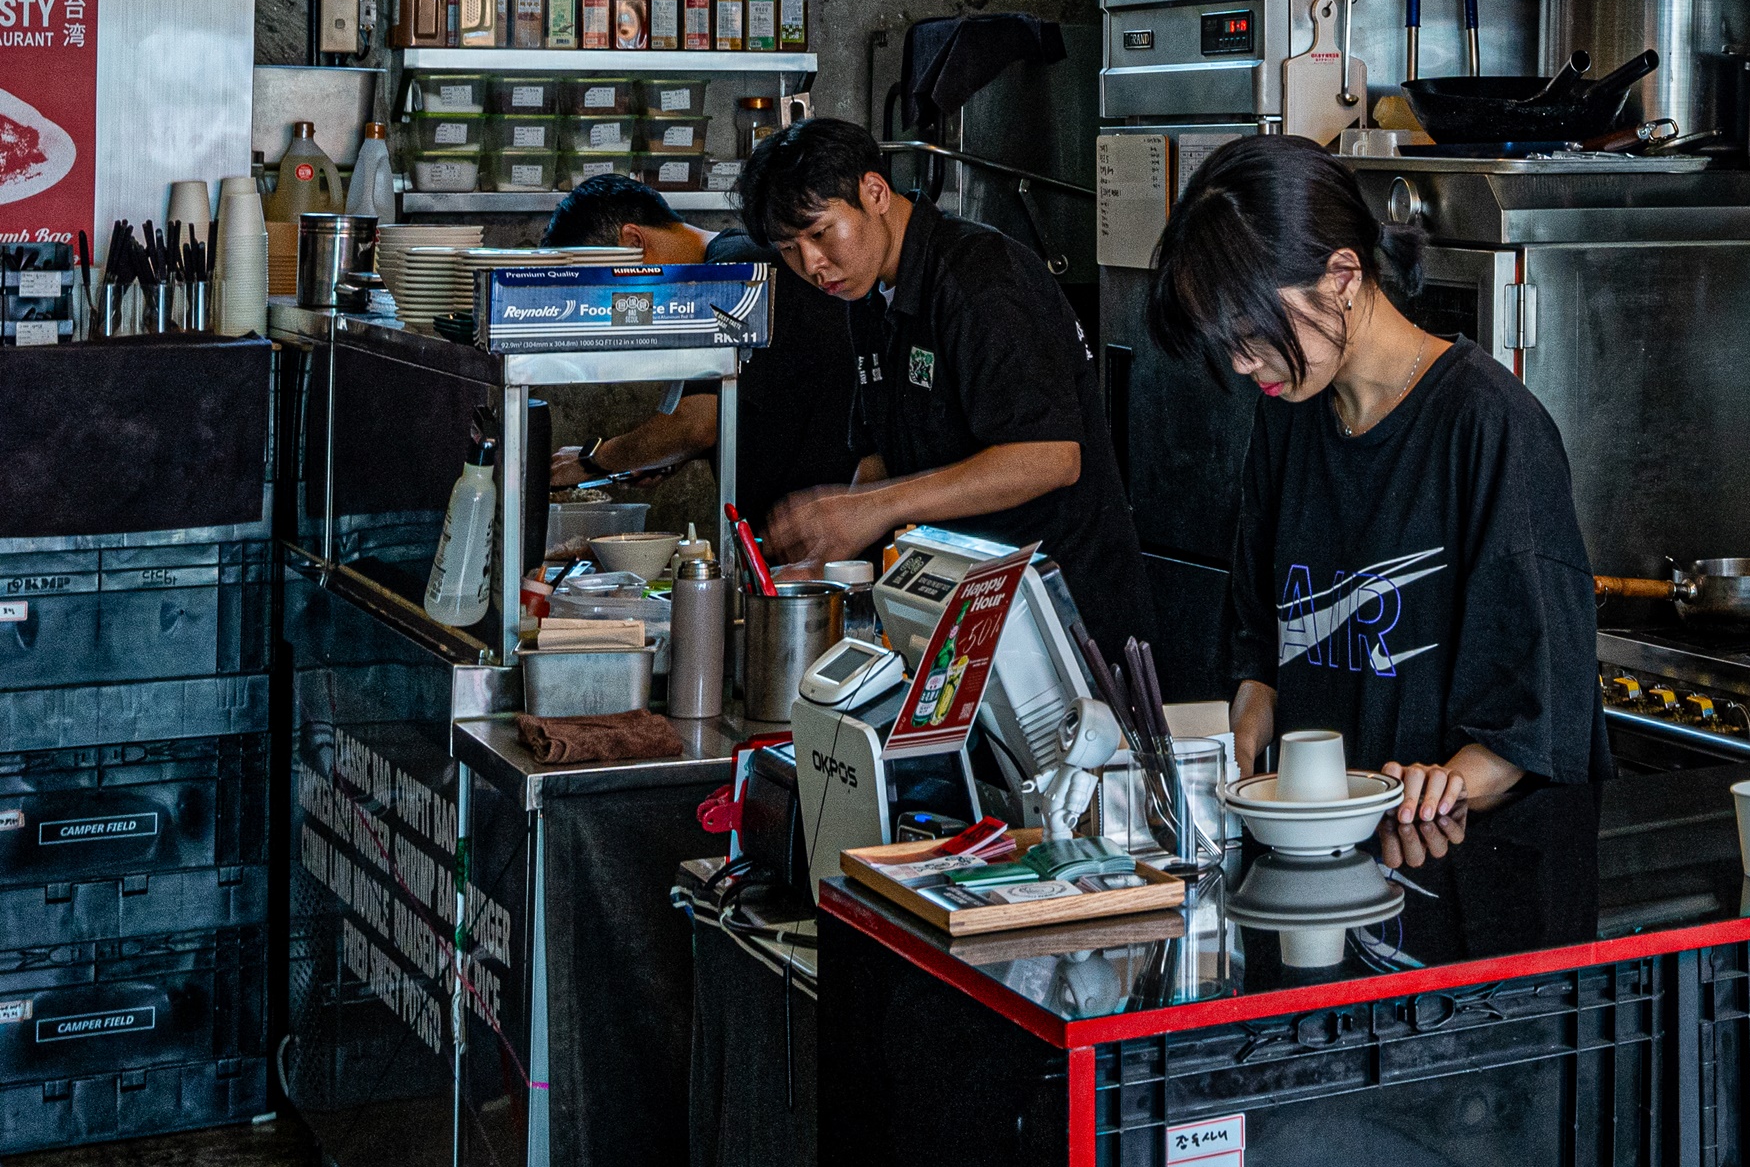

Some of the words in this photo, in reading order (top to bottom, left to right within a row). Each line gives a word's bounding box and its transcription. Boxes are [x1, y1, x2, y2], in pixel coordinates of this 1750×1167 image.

[35, 228, 72, 243] Bao
[504, 306, 561, 320] Reynolds
[670, 302, 694, 314] Foil
[961, 574, 1008, 599] Happy
[970, 593, 1005, 612] Hour
[1279, 564, 1401, 676] AIR
[812, 750, 857, 788] OKPOS
[372, 752, 391, 809] BAO
[434, 792, 456, 855] BAO
[60, 823, 104, 836] CAMPER
[106, 821, 136, 832] FIELD
[58, 1020, 102, 1033] CAMPER
[104, 1015, 134, 1027] FIELD
